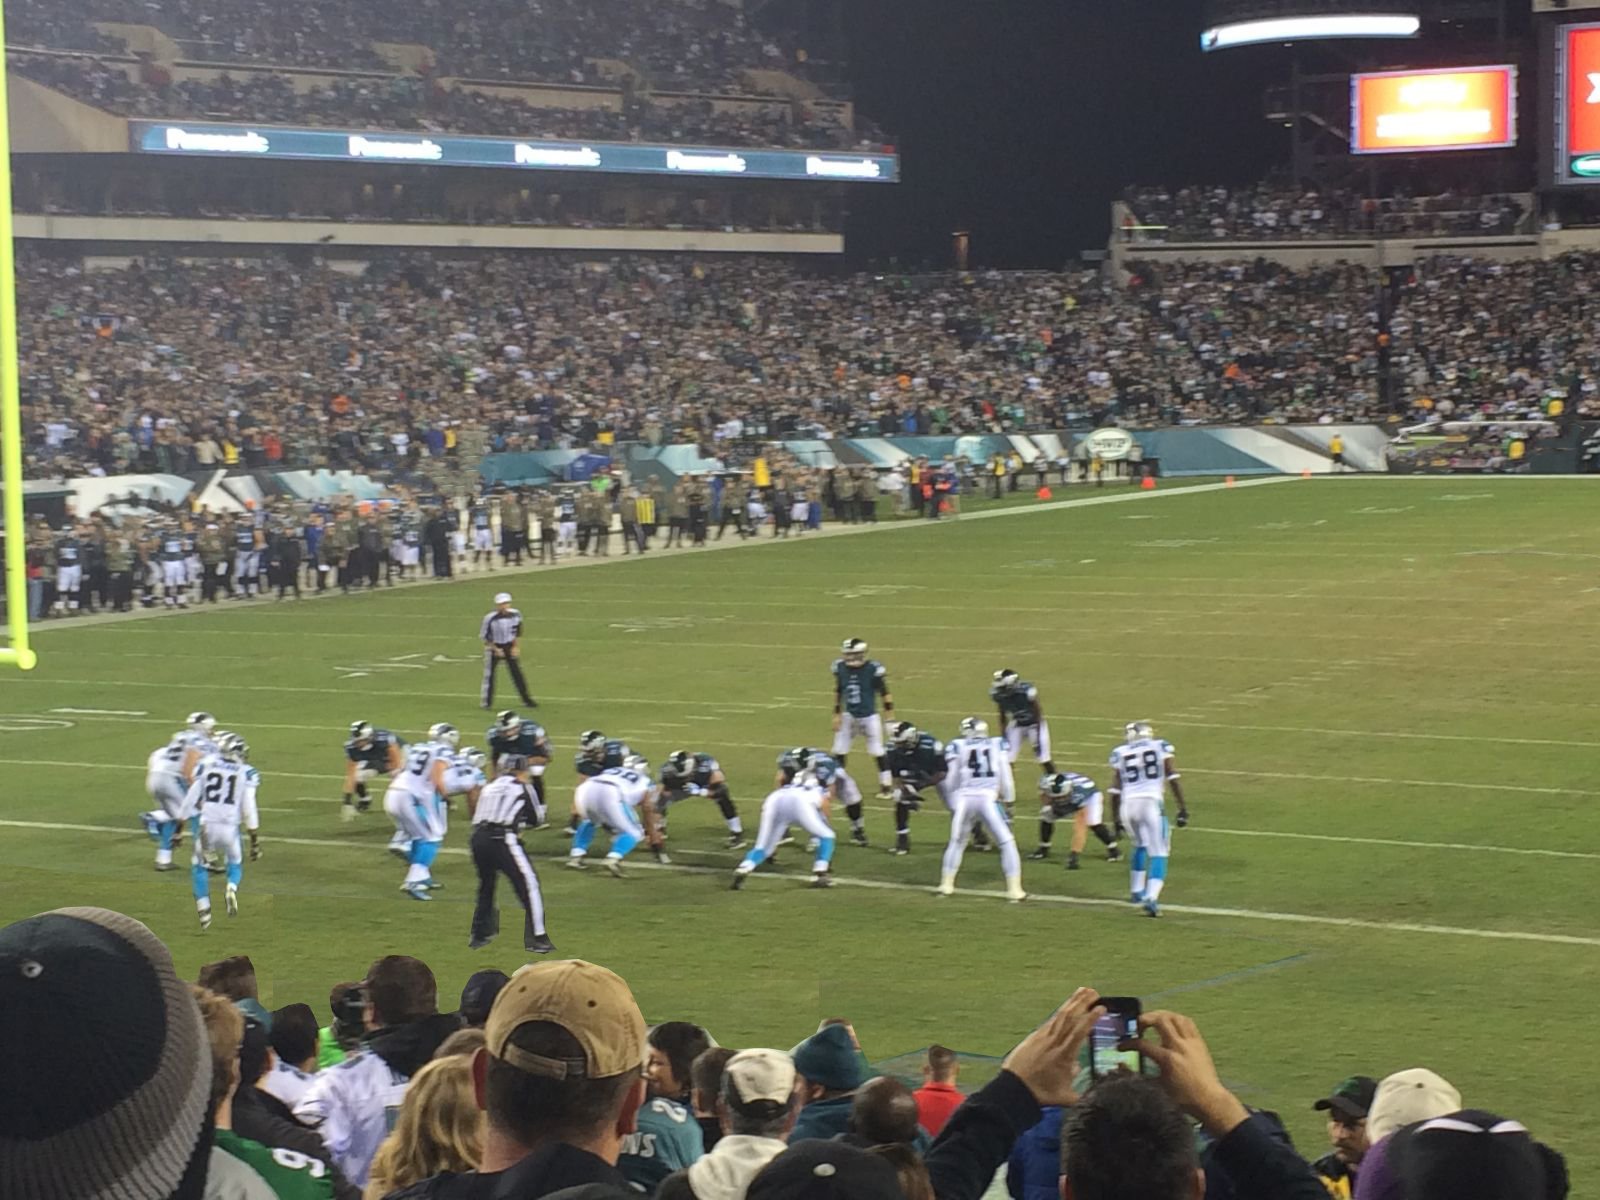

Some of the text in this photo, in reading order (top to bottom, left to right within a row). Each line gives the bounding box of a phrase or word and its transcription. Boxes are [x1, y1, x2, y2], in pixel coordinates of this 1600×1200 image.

[968, 749, 995, 777] 41
[1124, 751, 1159, 783] 58
[206, 772, 237, 804] 21
